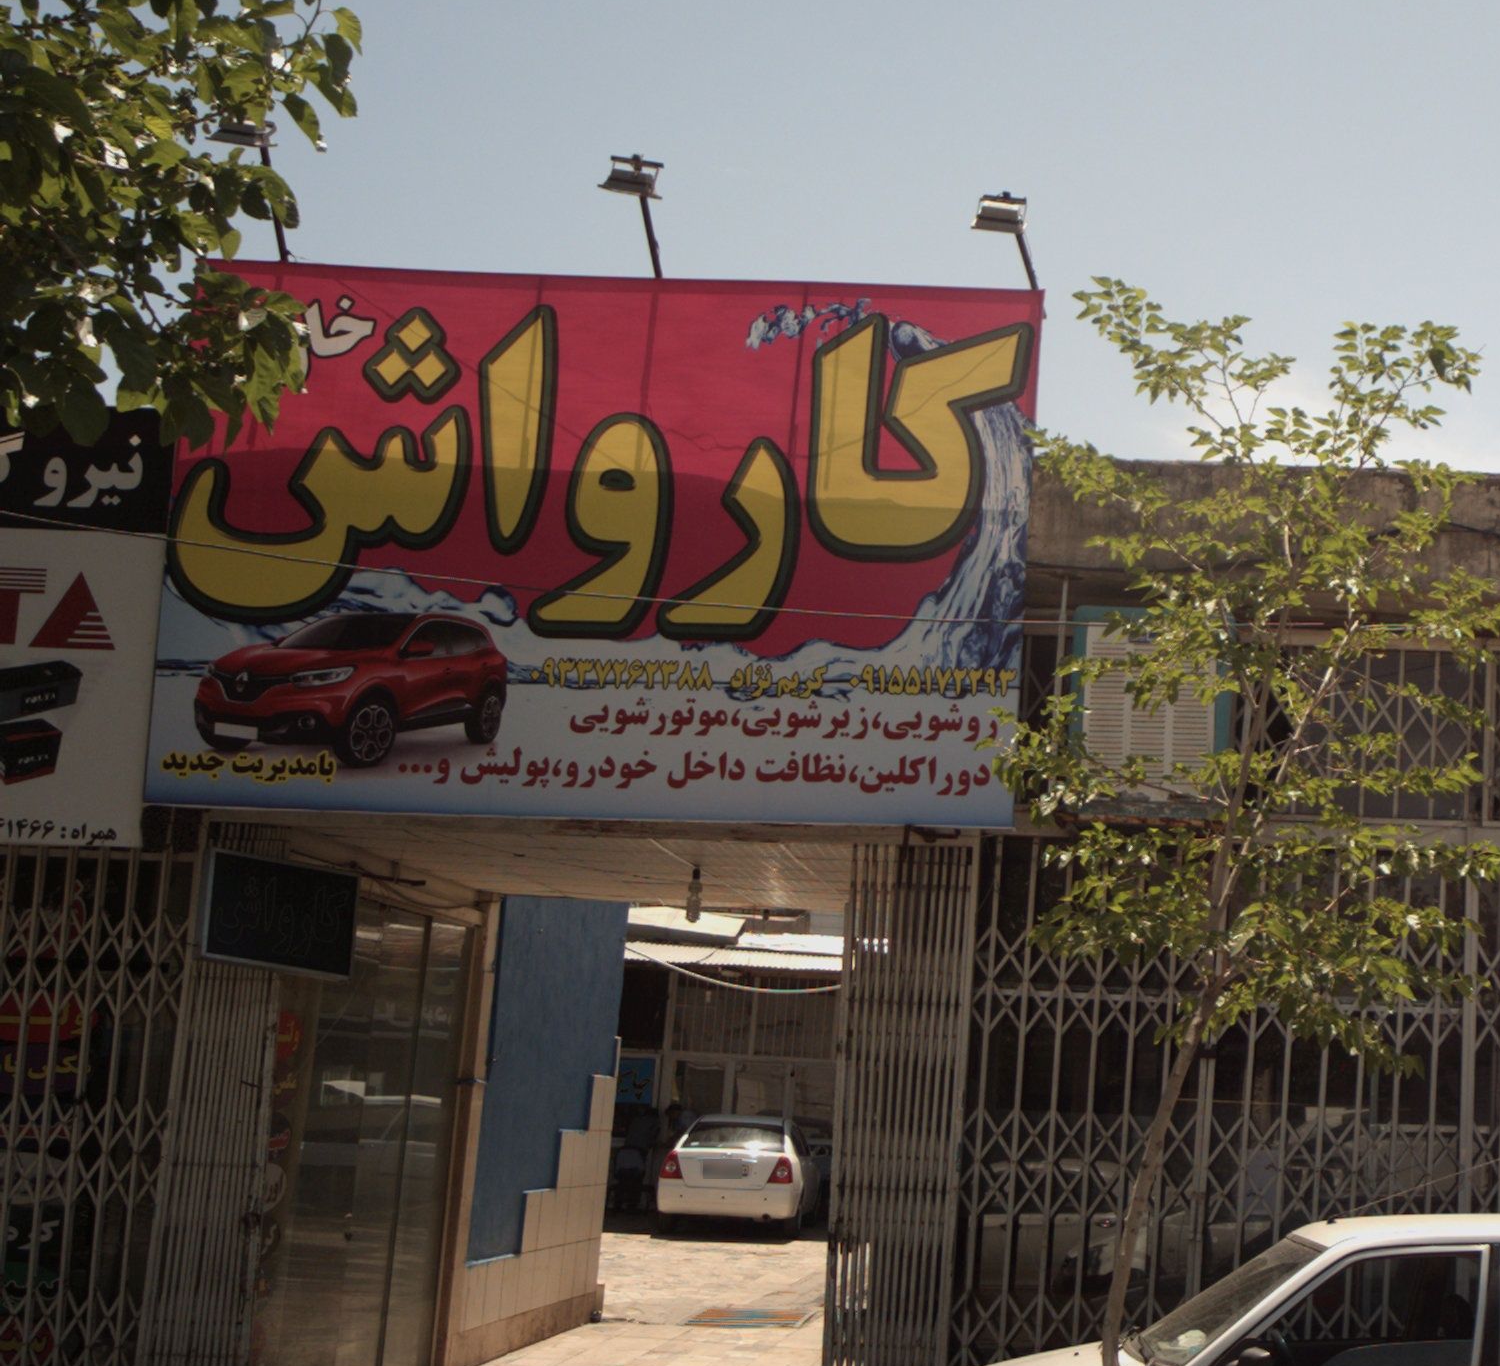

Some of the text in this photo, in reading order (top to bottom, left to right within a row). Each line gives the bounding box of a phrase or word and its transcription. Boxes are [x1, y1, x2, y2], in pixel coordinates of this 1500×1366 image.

[33, 434, 144, 508] نیرو
[166, 303, 1035, 638] کارواش
[162, 748, 226, 777] جدید
[667, 750, 746, 789] داخل
